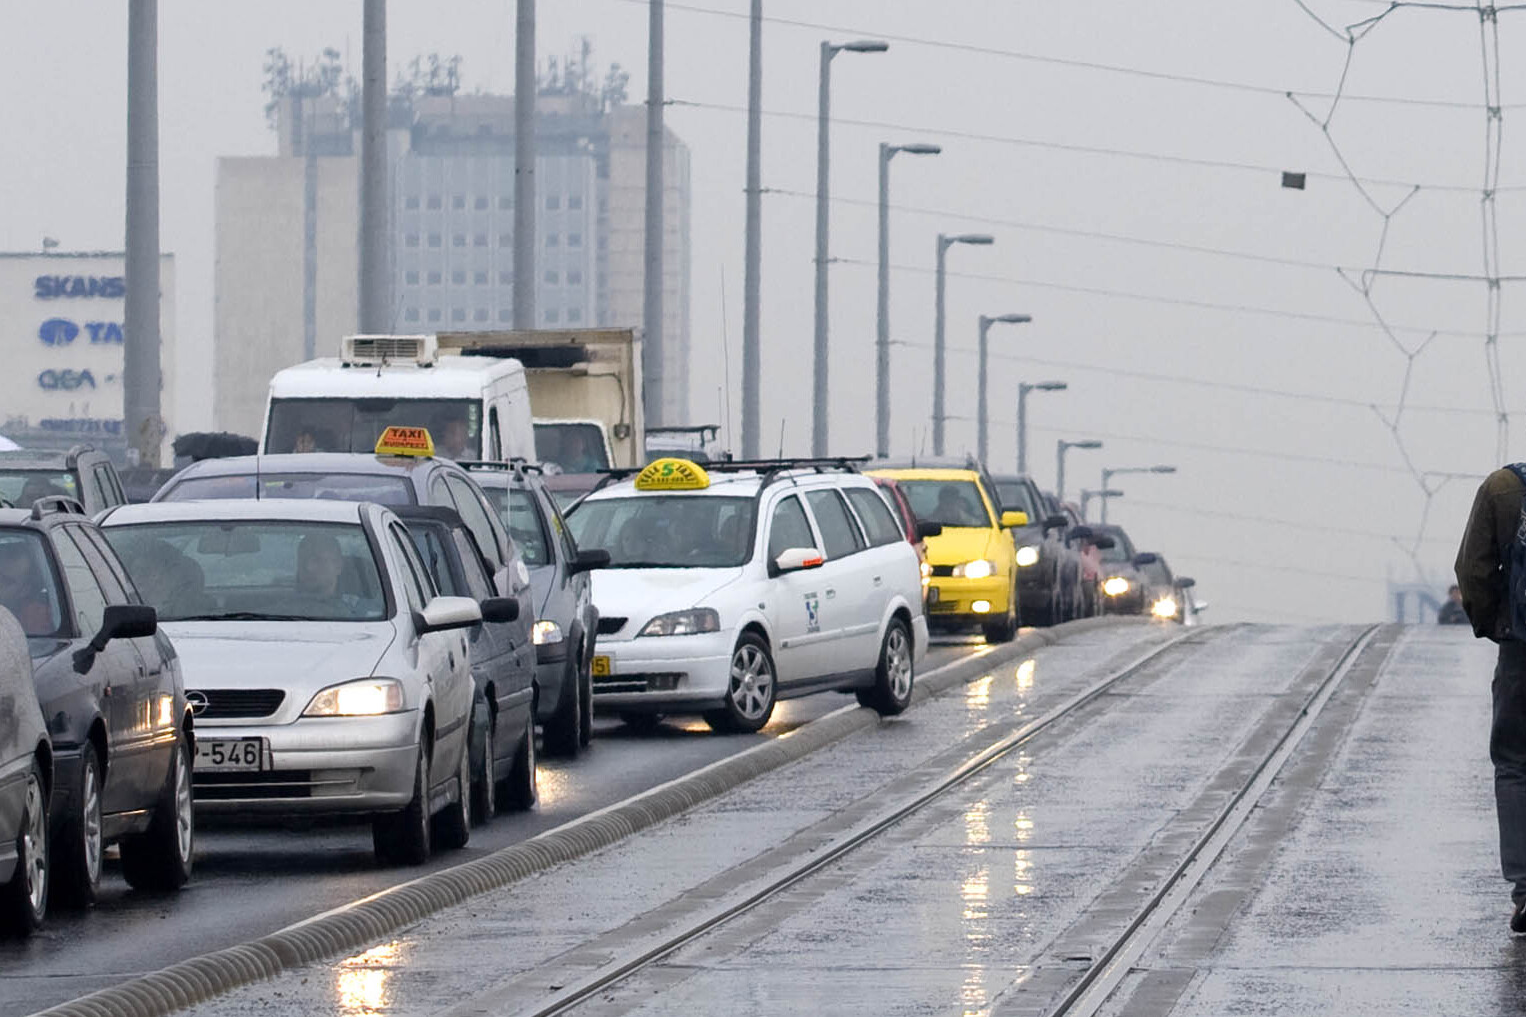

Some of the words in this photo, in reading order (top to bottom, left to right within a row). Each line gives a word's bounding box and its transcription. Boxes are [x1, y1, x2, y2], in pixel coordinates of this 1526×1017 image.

[84, 322, 125, 344] TA
[391, 429, 422, 438] TAXI
[195, 743, 257, 765] -546
